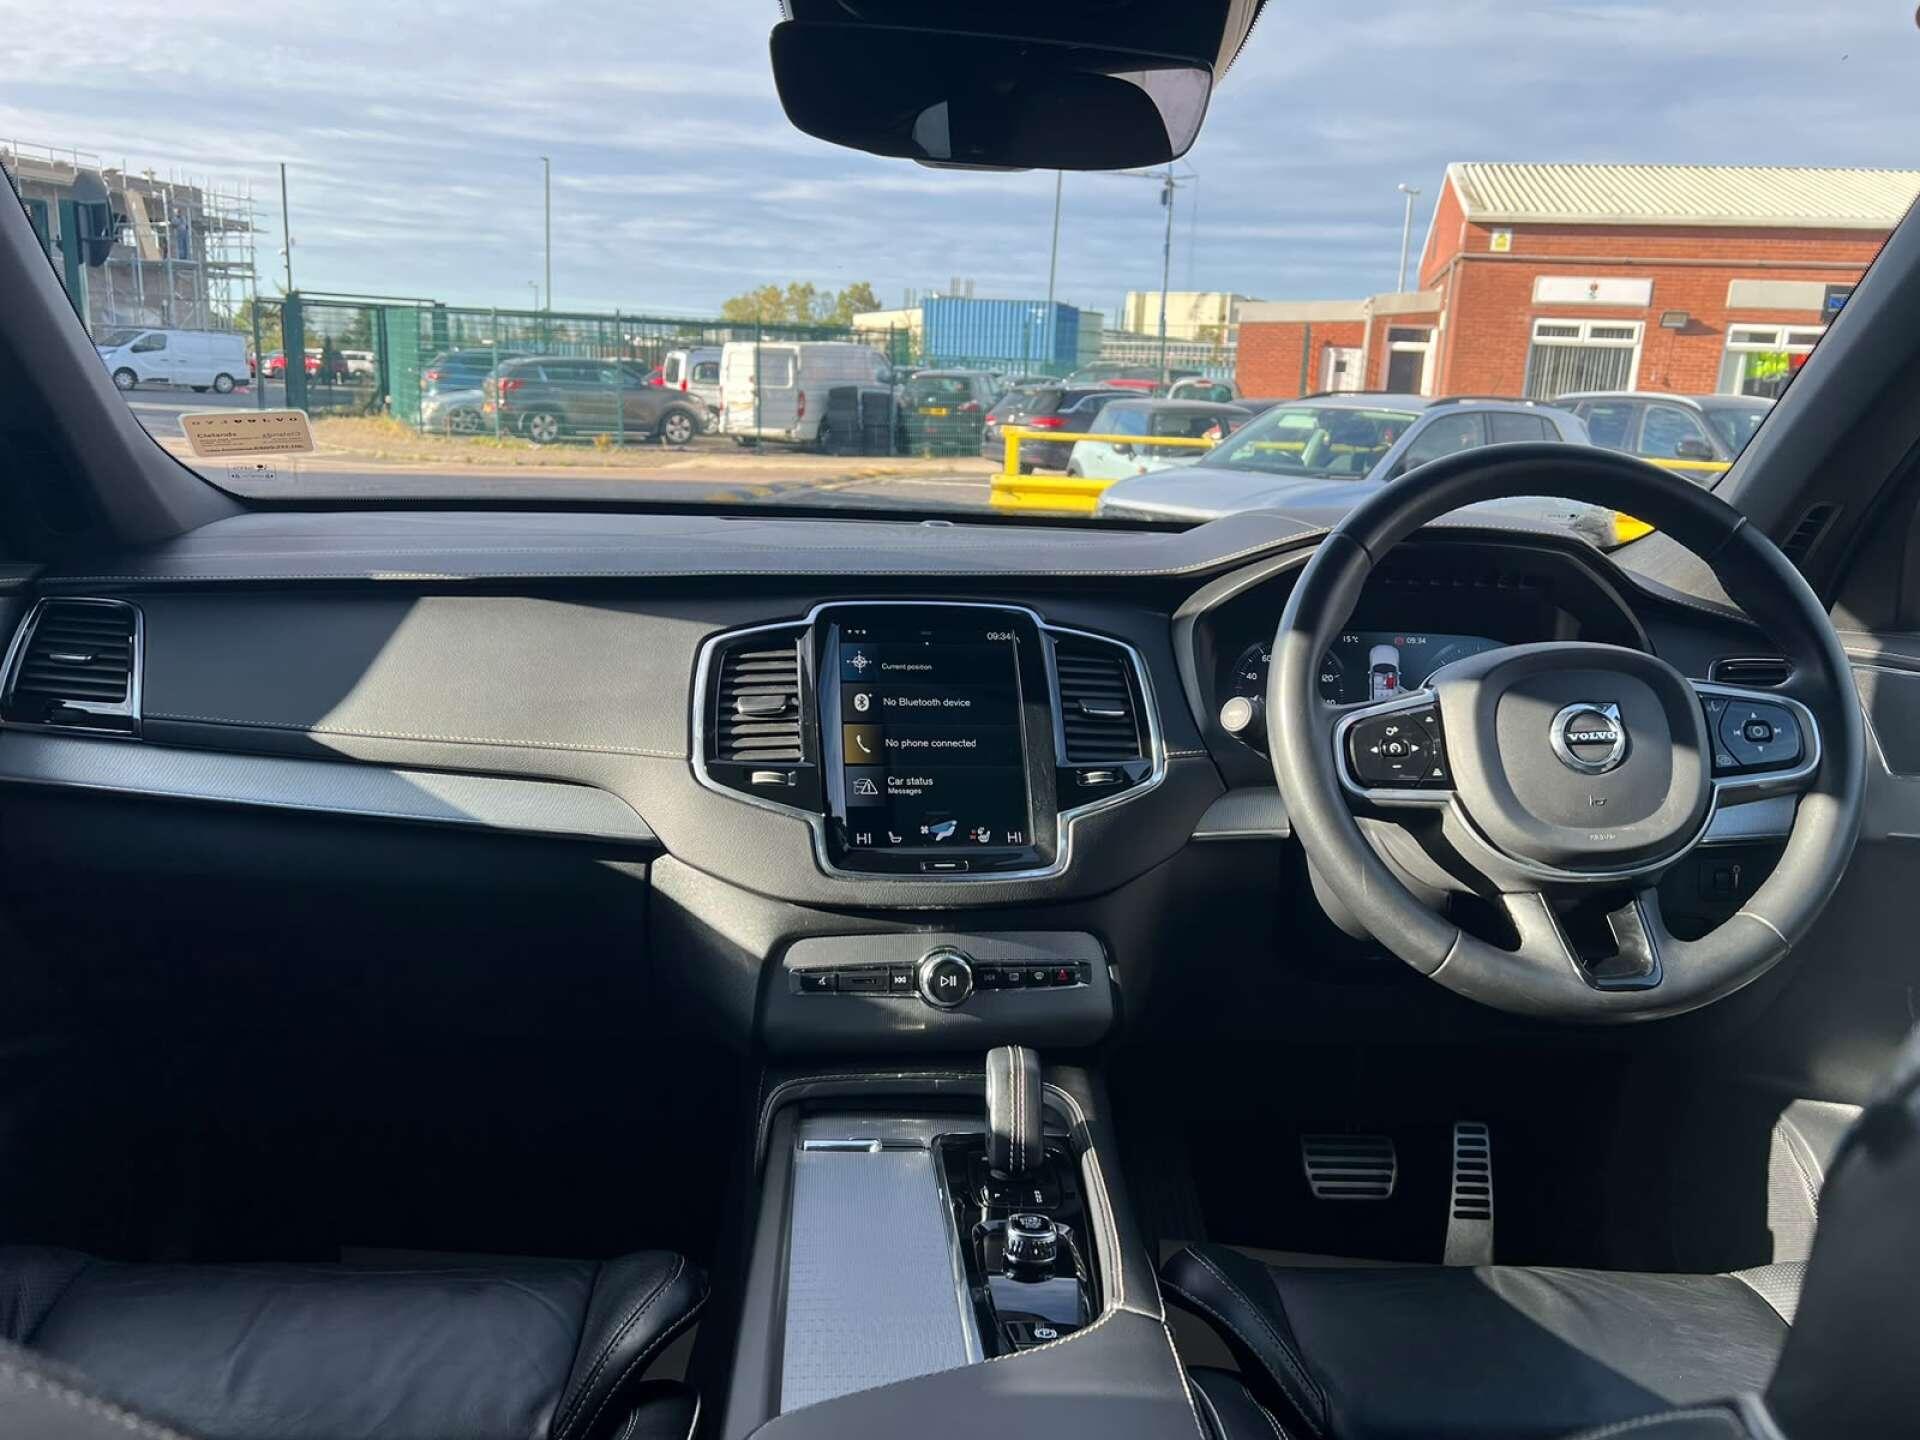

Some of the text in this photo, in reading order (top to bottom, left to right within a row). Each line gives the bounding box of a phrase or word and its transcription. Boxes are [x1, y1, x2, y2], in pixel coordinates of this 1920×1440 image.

[987, 632, 1011, 641] 09:34
[1261, 654, 1271, 662] 60
[906, 663, 932, 671] position
[1246, 672, 1257, 680] 40
[1321, 673, 1333, 682] 120
[883, 698, 971, 707] No Bluetooth device
[1567, 732, 1617, 741] VOLVO
[885, 738, 977, 750] No phone connected
[887, 776, 933, 786] Car status
[888, 787, 922, 795] Messages
[856, 833, 871, 844] HI
[1008, 831, 1022, 843] HI
